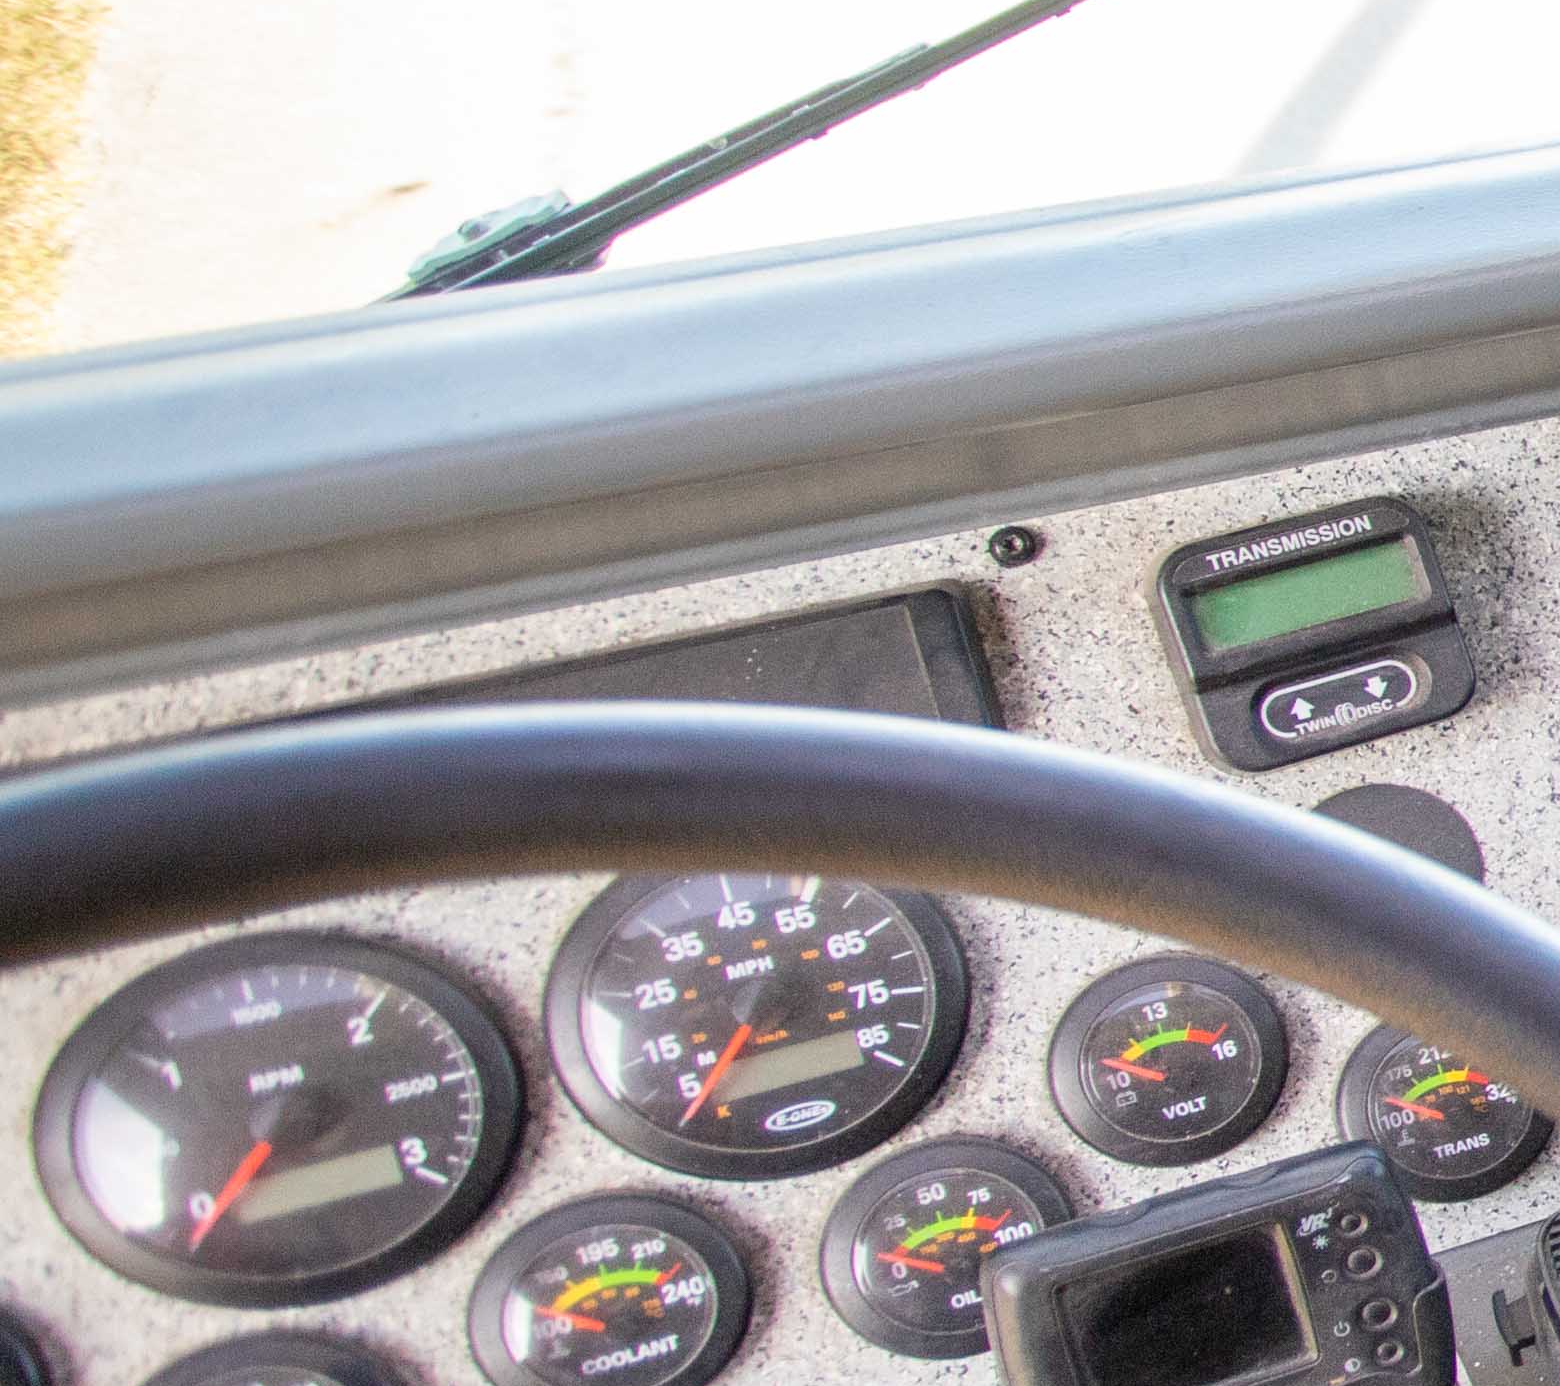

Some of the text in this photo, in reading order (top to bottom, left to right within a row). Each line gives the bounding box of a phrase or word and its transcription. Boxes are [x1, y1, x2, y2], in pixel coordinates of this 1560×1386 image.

[1205, 514, 1373, 570] TRANSMISSION
[1295, 699, 1394, 735] TWIN DISC
[718, 903, 756, 929] 45
[775, 906, 816, 933] 55
[663, 932, 703, 962] 35
[827, 930, 866, 958] 65
[726, 957, 774, 979] MPH
[635, 979, 677, 1009] 25
[848, 979, 889, 1009] 75
[1142, 1002, 1169, 1021] 13
[348, 1016, 374, 1045] 2
[857, 1025, 889, 1048] 85
[642, 1034, 681, 1064] 15
[1211, 1041, 1238, 1061] 16
[250, 1065, 304, 1093] RPM
[678, 1073, 701, 1099] 5
[1105, 1071, 1131, 1091] 10
[1387, 1065, 1412, 1081] 175
[1162, 1096, 1208, 1121] VOLT
[1381, 1109, 1414, 1130] 100
[401, 1138, 427, 1167] 3
[1433, 1133, 1491, 1159] TRANS
[917, 1183, 946, 1205] 50
[967, 1187, 991, 1205] 75
[884, 1214, 906, 1231] 25
[994, 1222, 1035, 1246] 100
[576, 1237, 619, 1264] 195
[631, 1239, 666, 1260] 210
[892, 1263, 907, 1278] 0
[661, 1275, 705, 1305] 240
[950, 1290, 983, 1309] OIL
[581, 1334, 680, 1375] COOLANT
